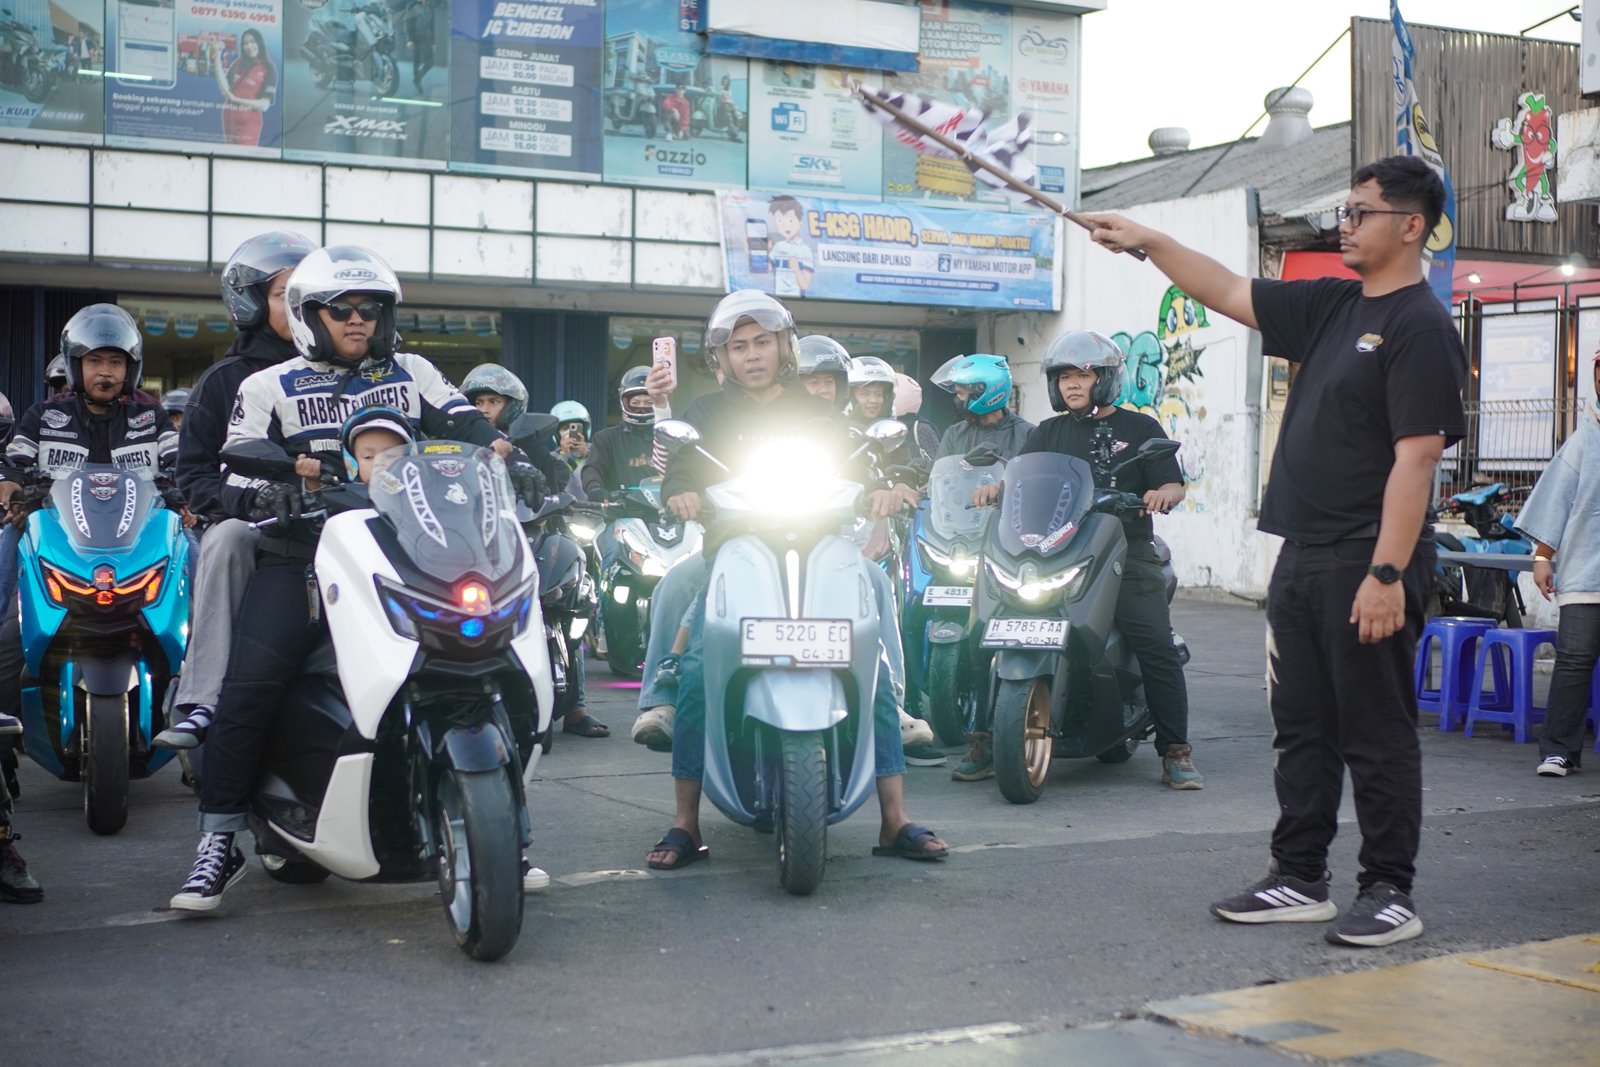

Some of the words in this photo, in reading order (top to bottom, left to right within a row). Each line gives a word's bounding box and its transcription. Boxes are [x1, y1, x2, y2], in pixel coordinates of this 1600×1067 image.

[191, 7, 217, 16] 0877
[249, 14, 276, 23] 4998
[493, 2, 564, 21] BENGKEL
[481, 19, 503, 38] JG
[505, 20, 575, 40] CIREBON
[942, 22, 980, 33] MOTOR
[920, 39, 949, 50] OTOR
[927, 31, 959, 41] KAMU
[960, 33, 1002, 45] DENGAN
[496, 48, 522, 59] SENIN
[529, 52, 560, 63] JUMAT
[484, 60, 509, 71] JAM
[512, 86, 540, 96] SABTU
[1029, 79, 1069, 96] YAMAHA
[112, 92, 144, 104] Booking
[146, 96, 181, 106] sekarang
[7, 106, 37, 117] KUAT
[325, 115, 407, 131] XMAX
[509, 121, 546, 131] MINGGU
[775, 115, 787, 125] Wi
[793, 116, 802, 125] Fi
[323, 128, 369, 137] TECH
[371, 131, 408, 140] MAX
[485, 130, 509, 142] JAM
[645, 144, 707, 166] Fazzio
[660, 167, 692, 175] HYBRID
[808, 210, 860, 240] E-KSG
[862, 213, 919, 248] HADIR,
[822, 250, 861, 264] LANGSUNG
[862, 253, 879, 264] DARI
[880, 255, 912, 267] APLIKASI
[953, 258, 962, 270] MY
[964, 259, 991, 271] YAMAHA
[993, 261, 1017, 274] MOTOR
[1018, 263, 1032, 274] APP
[297, 396, 350, 428] RABBIT
[928, 587, 935, 596] E
[746, 624, 755, 640] E
[776, 625, 816, 641] 5220
[992, 621, 1000, 632] H
[1006, 621, 1036, 632] 5785
[1039, 622, 1062, 633] FAA
